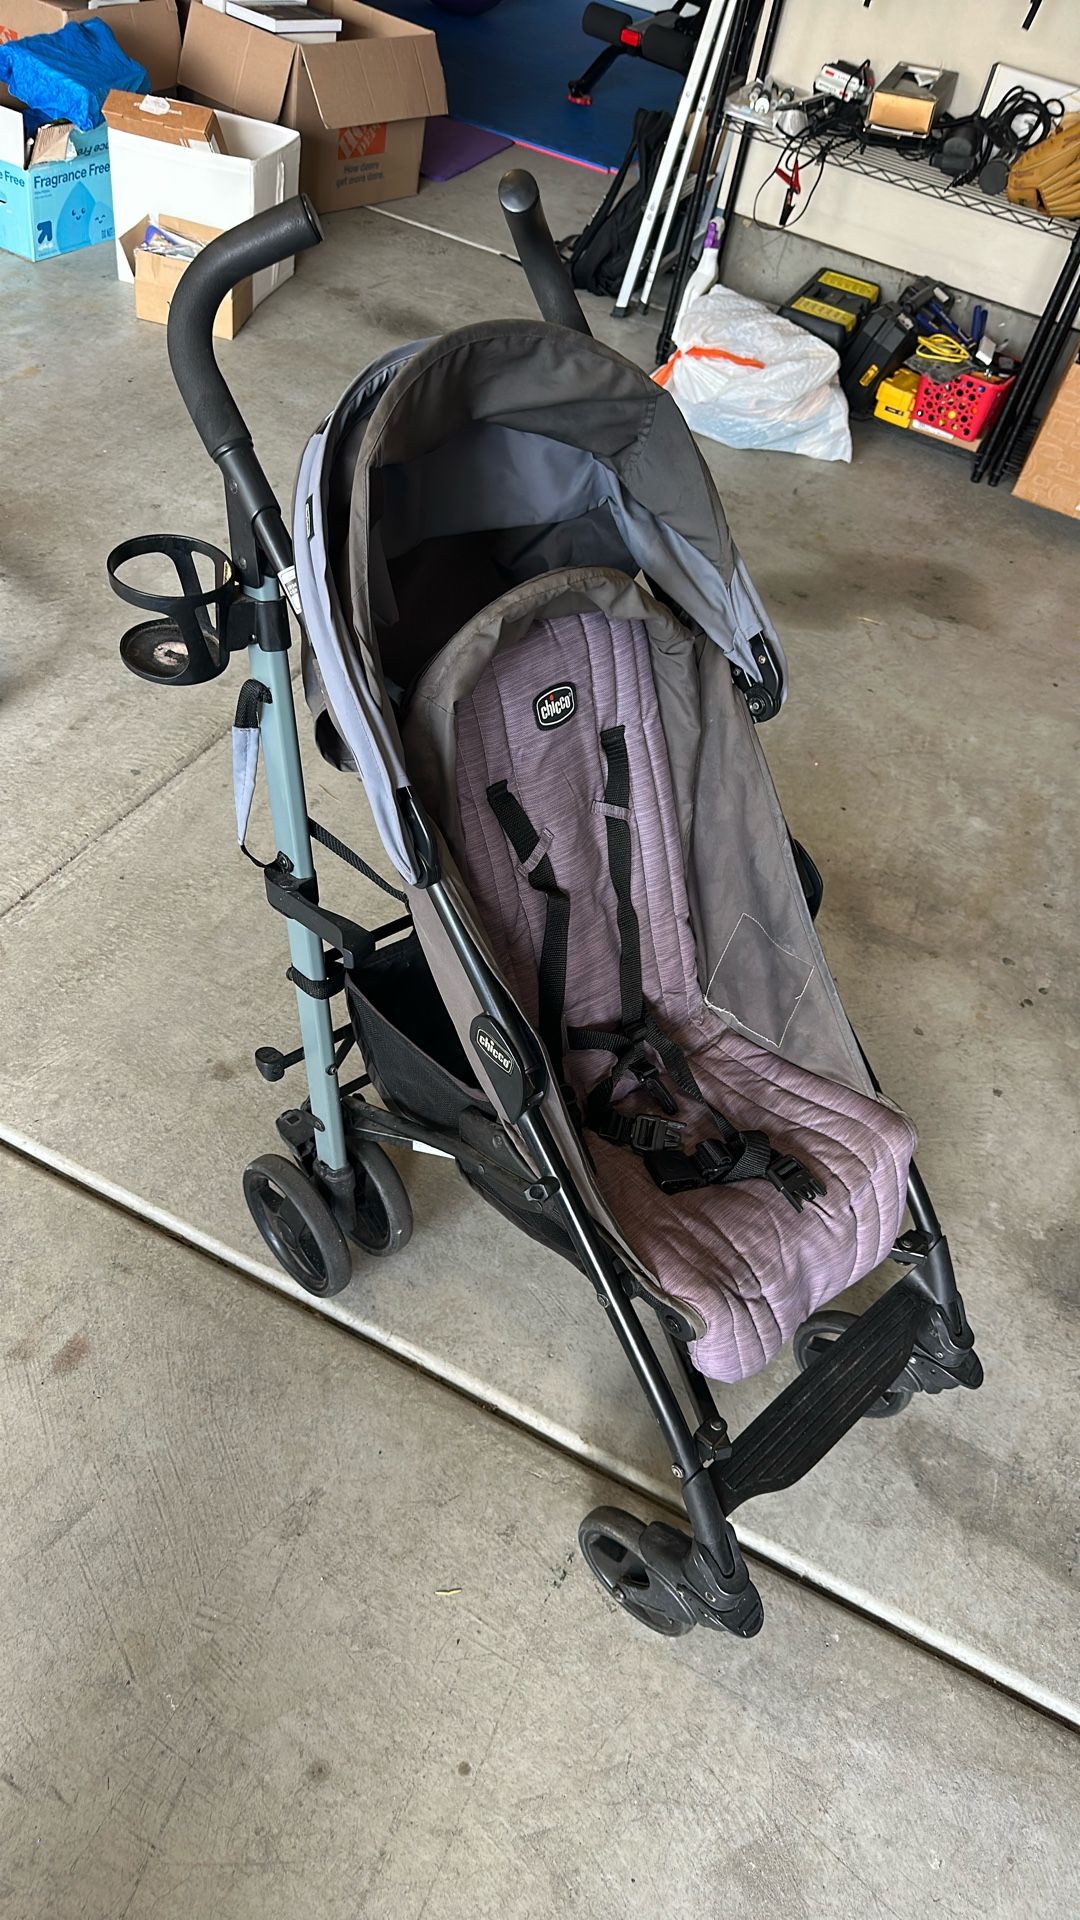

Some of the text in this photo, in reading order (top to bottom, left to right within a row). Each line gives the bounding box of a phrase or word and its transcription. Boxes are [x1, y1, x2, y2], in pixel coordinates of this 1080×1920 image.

[5, 171, 25, 187] Free
[34, 162, 110, 189] Fragrance Free
[540, 693, 571, 720] chicco
[479, 1035, 511, 1069] chicco
